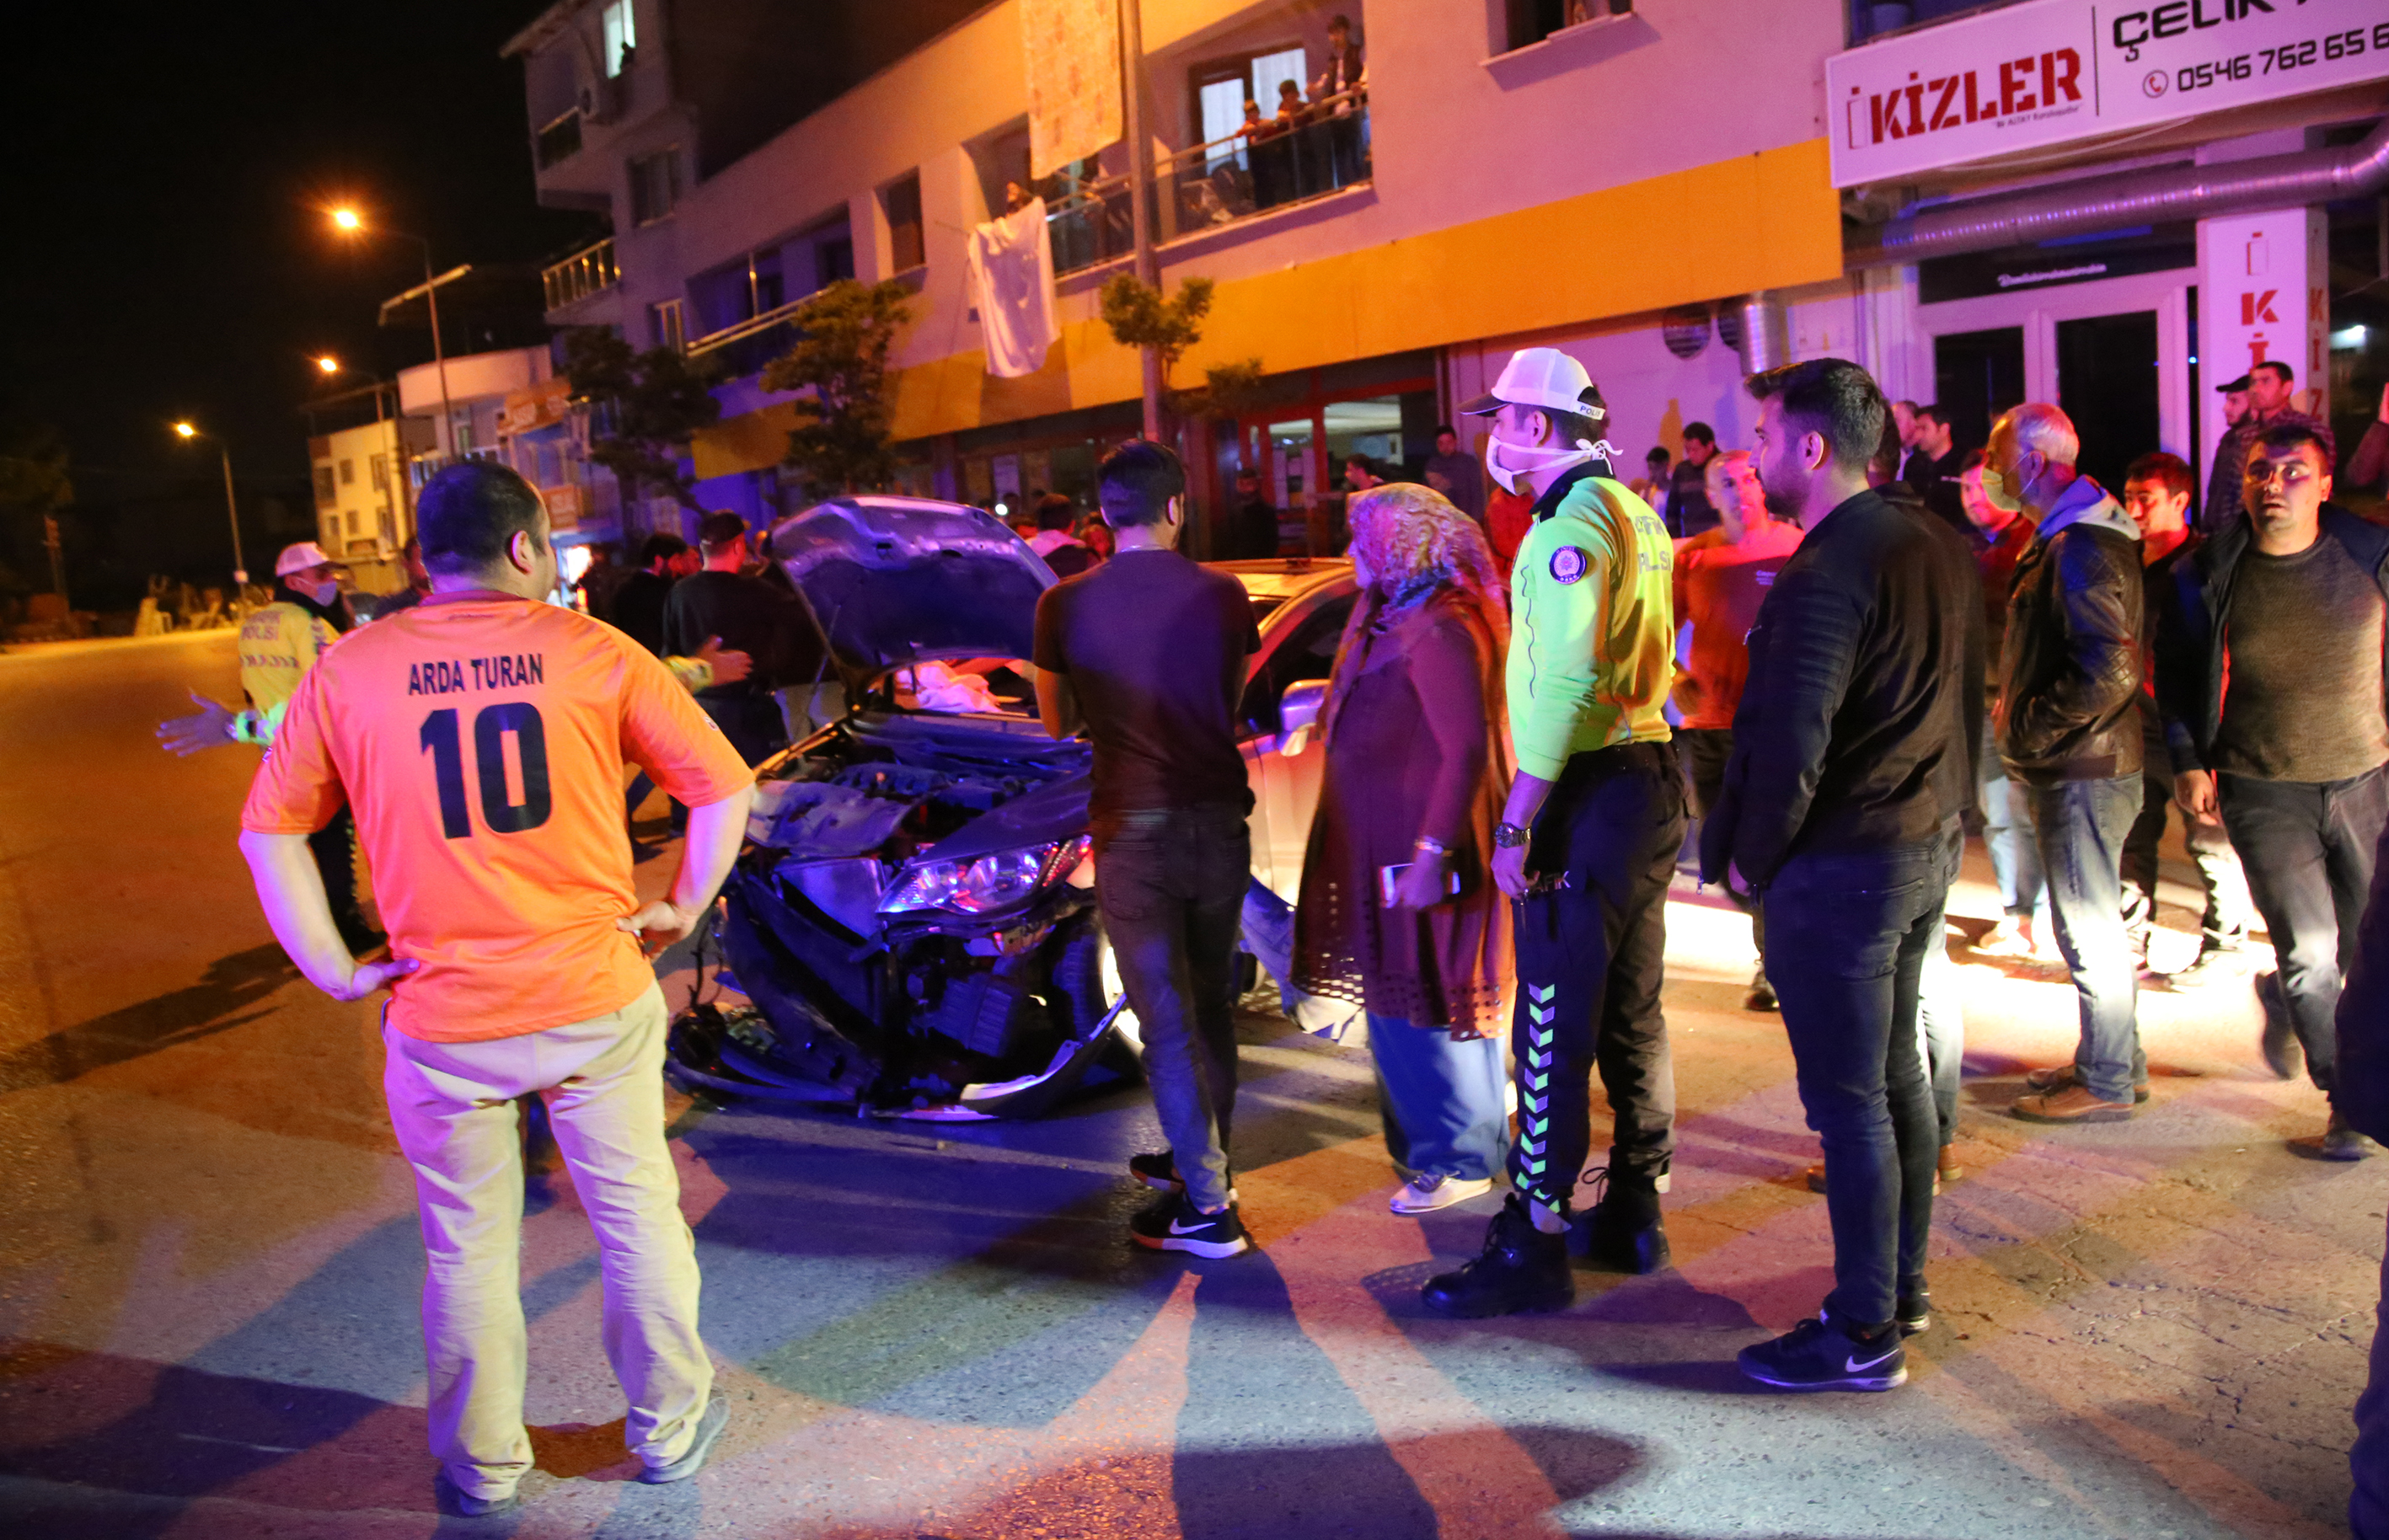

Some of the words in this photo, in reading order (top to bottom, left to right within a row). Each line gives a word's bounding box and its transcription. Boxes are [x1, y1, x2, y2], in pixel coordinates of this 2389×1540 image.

[2177, 55, 2252, 92] 0546
[2258, 40, 2317, 74] 762
[2324, 29, 2365, 61] 65
[409, 660, 465, 696] ARDA
[470, 653, 544, 690] TURAN
[420, 702, 552, 839] 10
